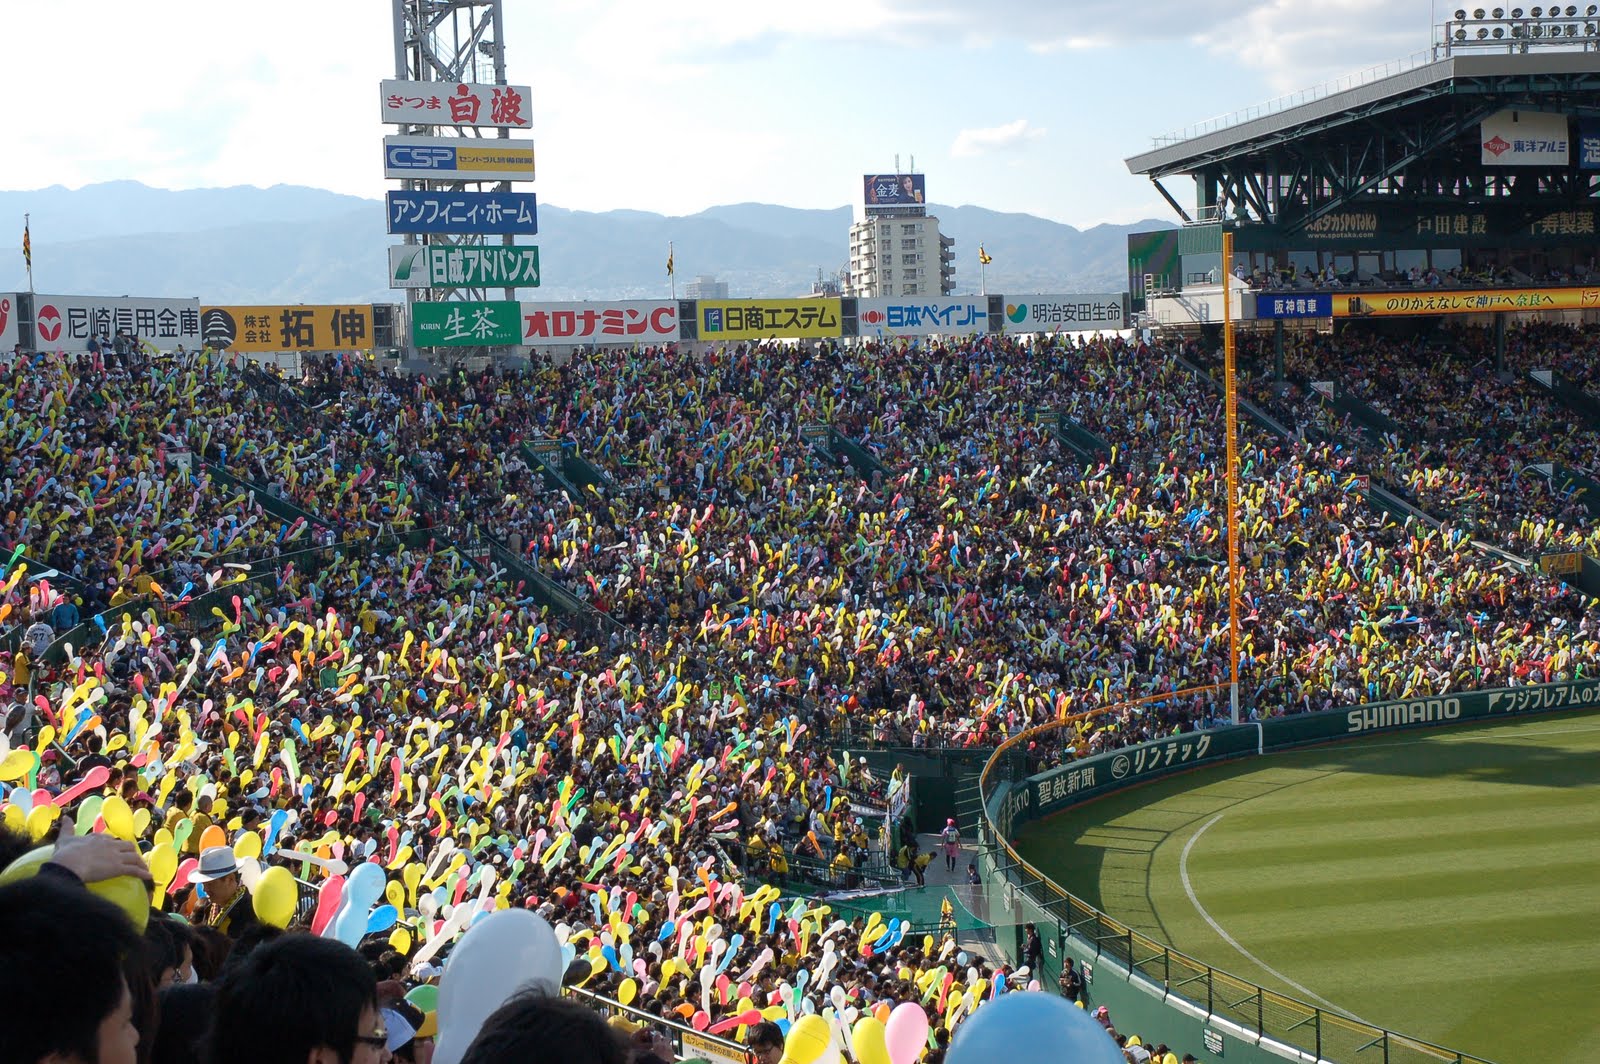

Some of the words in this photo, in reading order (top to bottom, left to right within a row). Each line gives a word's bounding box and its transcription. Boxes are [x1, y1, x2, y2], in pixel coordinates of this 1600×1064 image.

[387, 84, 527, 125] さつま白波
[1513, 140, 1567, 153] 東洋アルミ
[389, 148, 454, 168] CSP
[876, 183, 900, 197] 金麦
[1416, 214, 1488, 235] 戸田建設
[431, 248, 538, 284] 日成アドバンス
[1032, 302, 1121, 323] 明治安田生命
[1274, 299, 1317, 315] 阪神電車
[1386, 293, 1555, 311] のりかえなしで神戸へ奈良へ
[67, 307, 200, 339] 尼崎信用金庫
[243, 314, 271, 329] 株式
[420, 322, 441, 331] KIRIN
[443, 307, 499, 341] 生茶
[524, 307, 676, 338] オロナミンC
[726, 307, 838, 331] 日商エステム
[887, 304, 987, 328] 日本ペイント
[244, 330, 272, 344] 会社
[279, 309, 366, 347] 拓伸
[33, 632, 45, 641] 77
[1348, 698, 1460, 733] SHIMANO
[1134, 734, 1211, 774] リンテック
